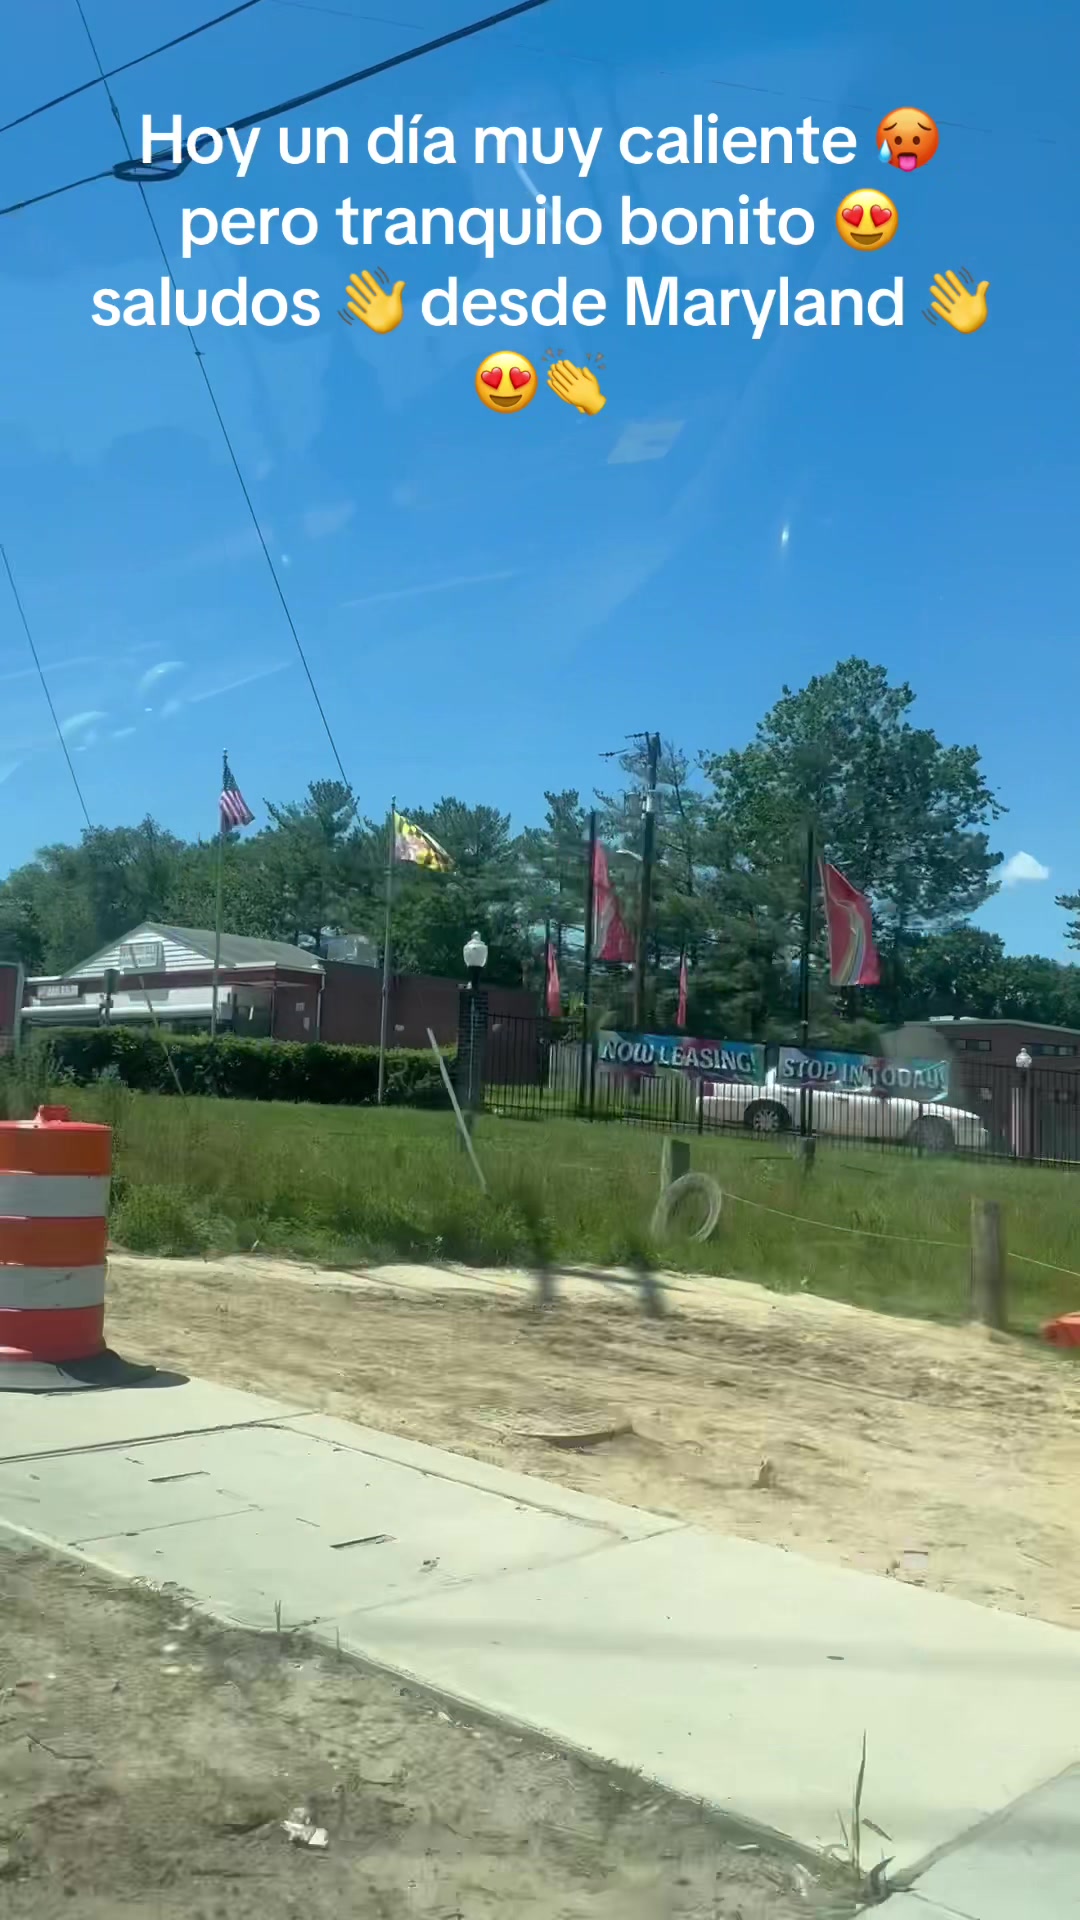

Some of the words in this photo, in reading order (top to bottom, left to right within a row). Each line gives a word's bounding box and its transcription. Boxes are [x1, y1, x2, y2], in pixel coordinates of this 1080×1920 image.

[600, 1040, 654, 1064] NOW
[659, 1044, 757, 1073] LEASING!
[783, 1057, 837, 1080] STOP
[842, 1064, 865, 1087] IN
